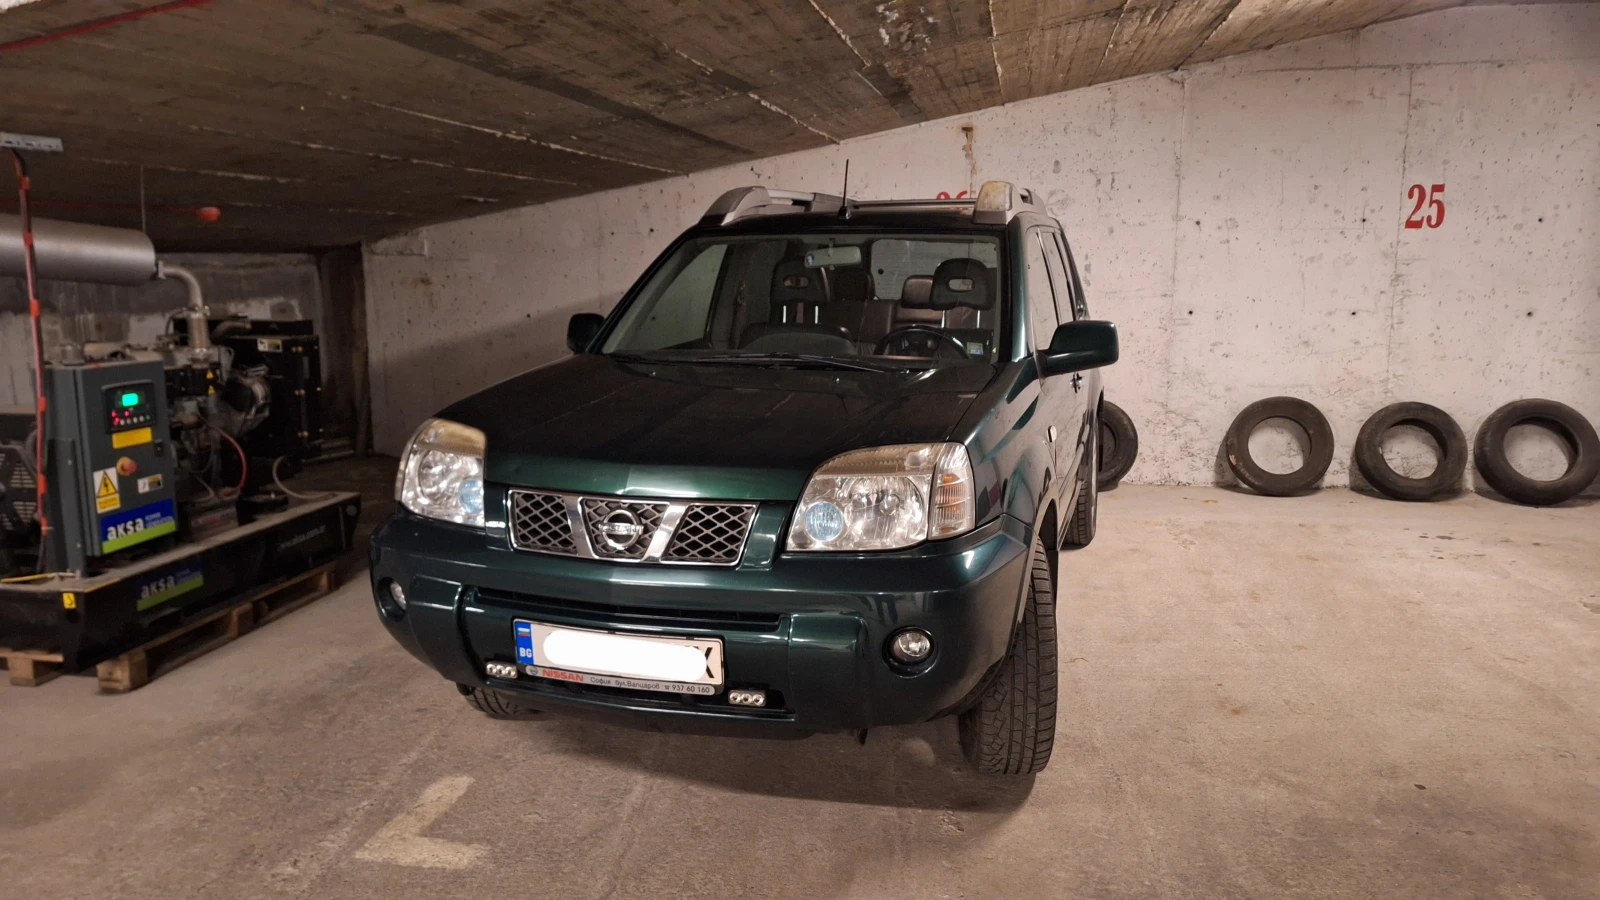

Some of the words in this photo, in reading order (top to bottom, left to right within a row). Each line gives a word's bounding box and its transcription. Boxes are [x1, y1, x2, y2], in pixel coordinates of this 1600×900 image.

[1404, 183, 1446, 229] 25
[519, 647, 532, 658] BG
[542, 669, 584, 682] NISSAN
[590, 676, 612, 685] София
[671, 684, 685, 692] 937
[686, 685, 696, 693] 60
[697, 686, 710, 694] 160
